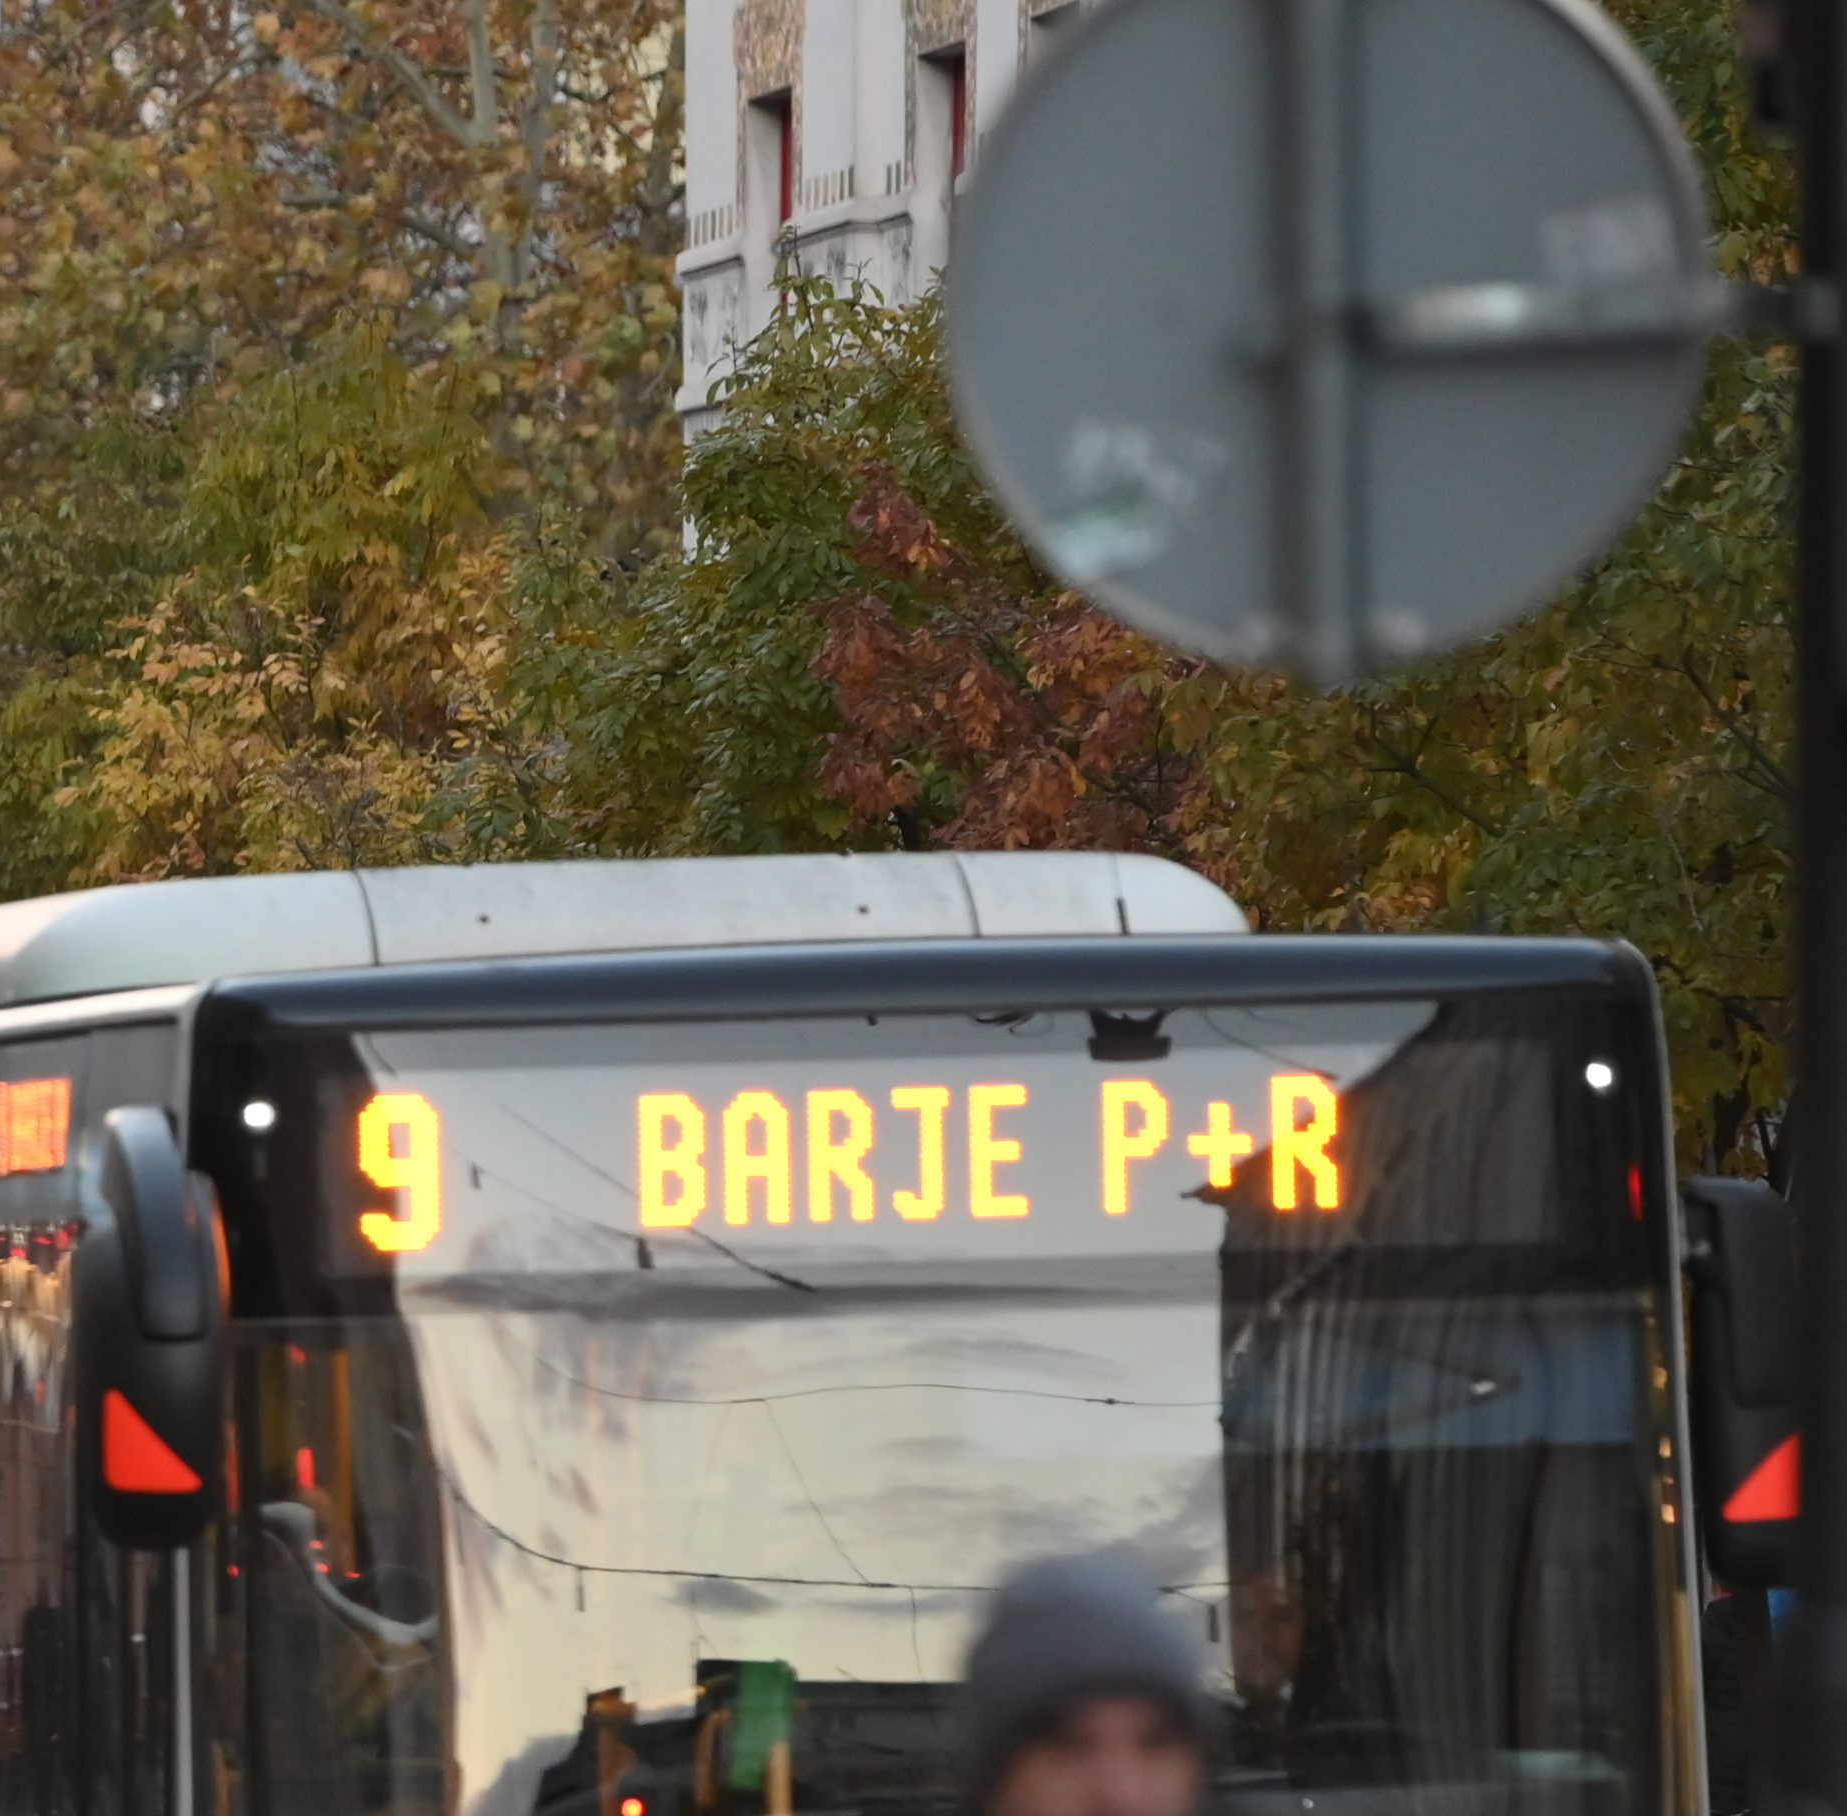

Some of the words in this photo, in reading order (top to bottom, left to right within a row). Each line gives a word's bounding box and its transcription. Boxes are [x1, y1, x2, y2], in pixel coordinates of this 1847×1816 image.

[357, 1093, 443, 1254] 9
[637, 1083, 1031, 1230] BARJE
[1101, 1072, 1342, 1216] P+R
